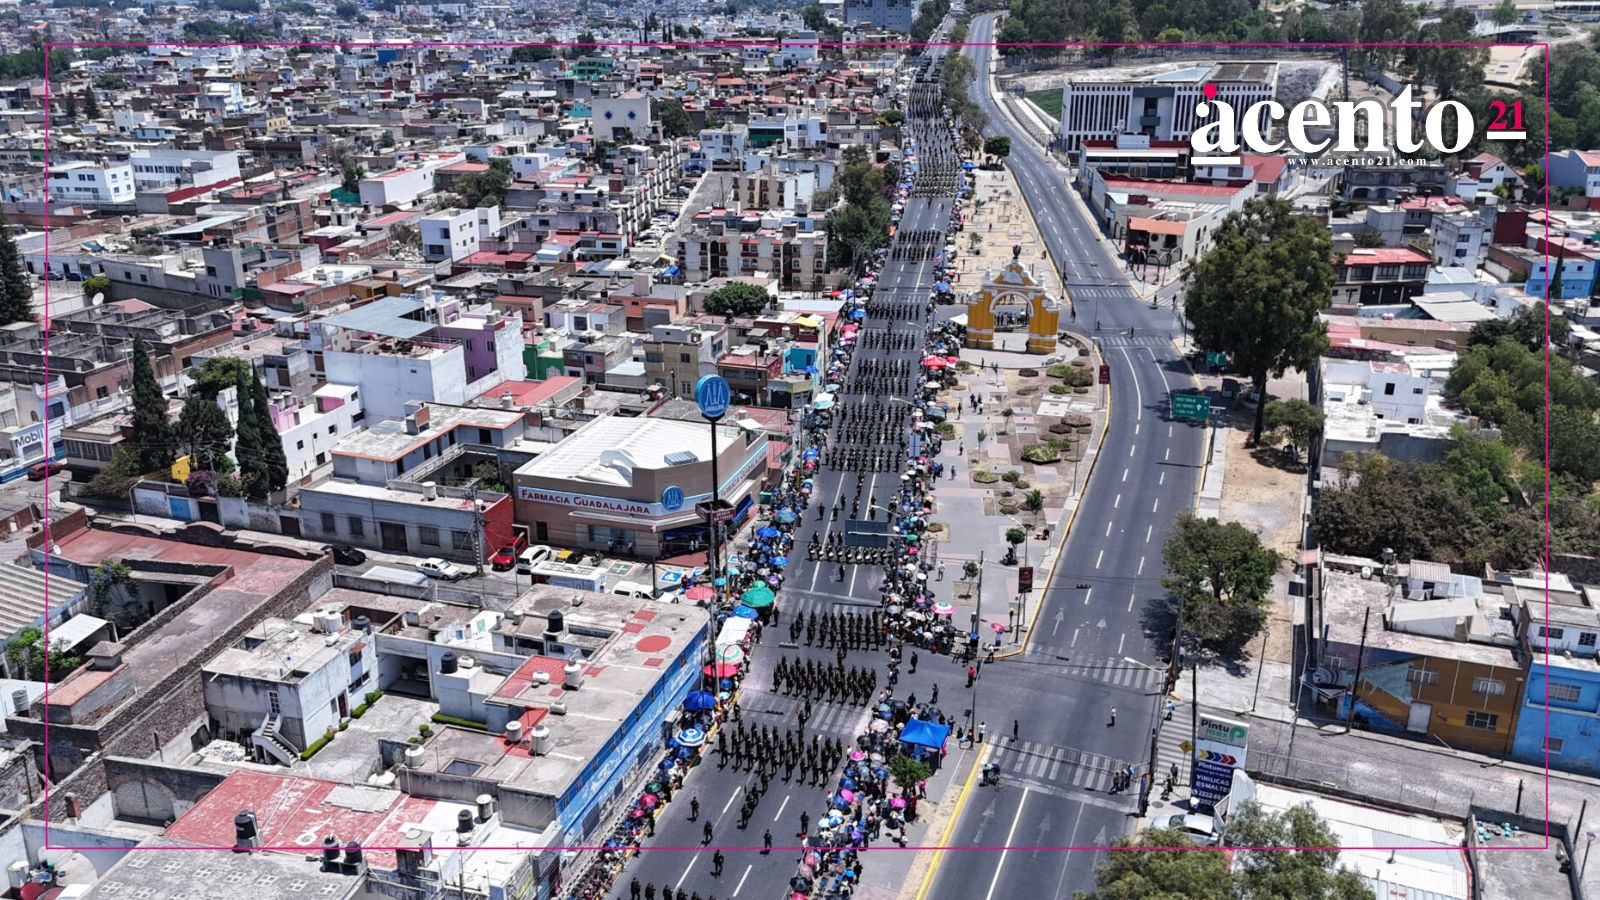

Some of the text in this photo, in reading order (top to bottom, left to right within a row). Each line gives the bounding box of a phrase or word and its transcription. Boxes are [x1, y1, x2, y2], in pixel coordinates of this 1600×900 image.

[15, 429, 43, 448] Mobil
[573, 496, 650, 515] GUADALAJARA
[1200, 719, 1229, 732] Pintu
